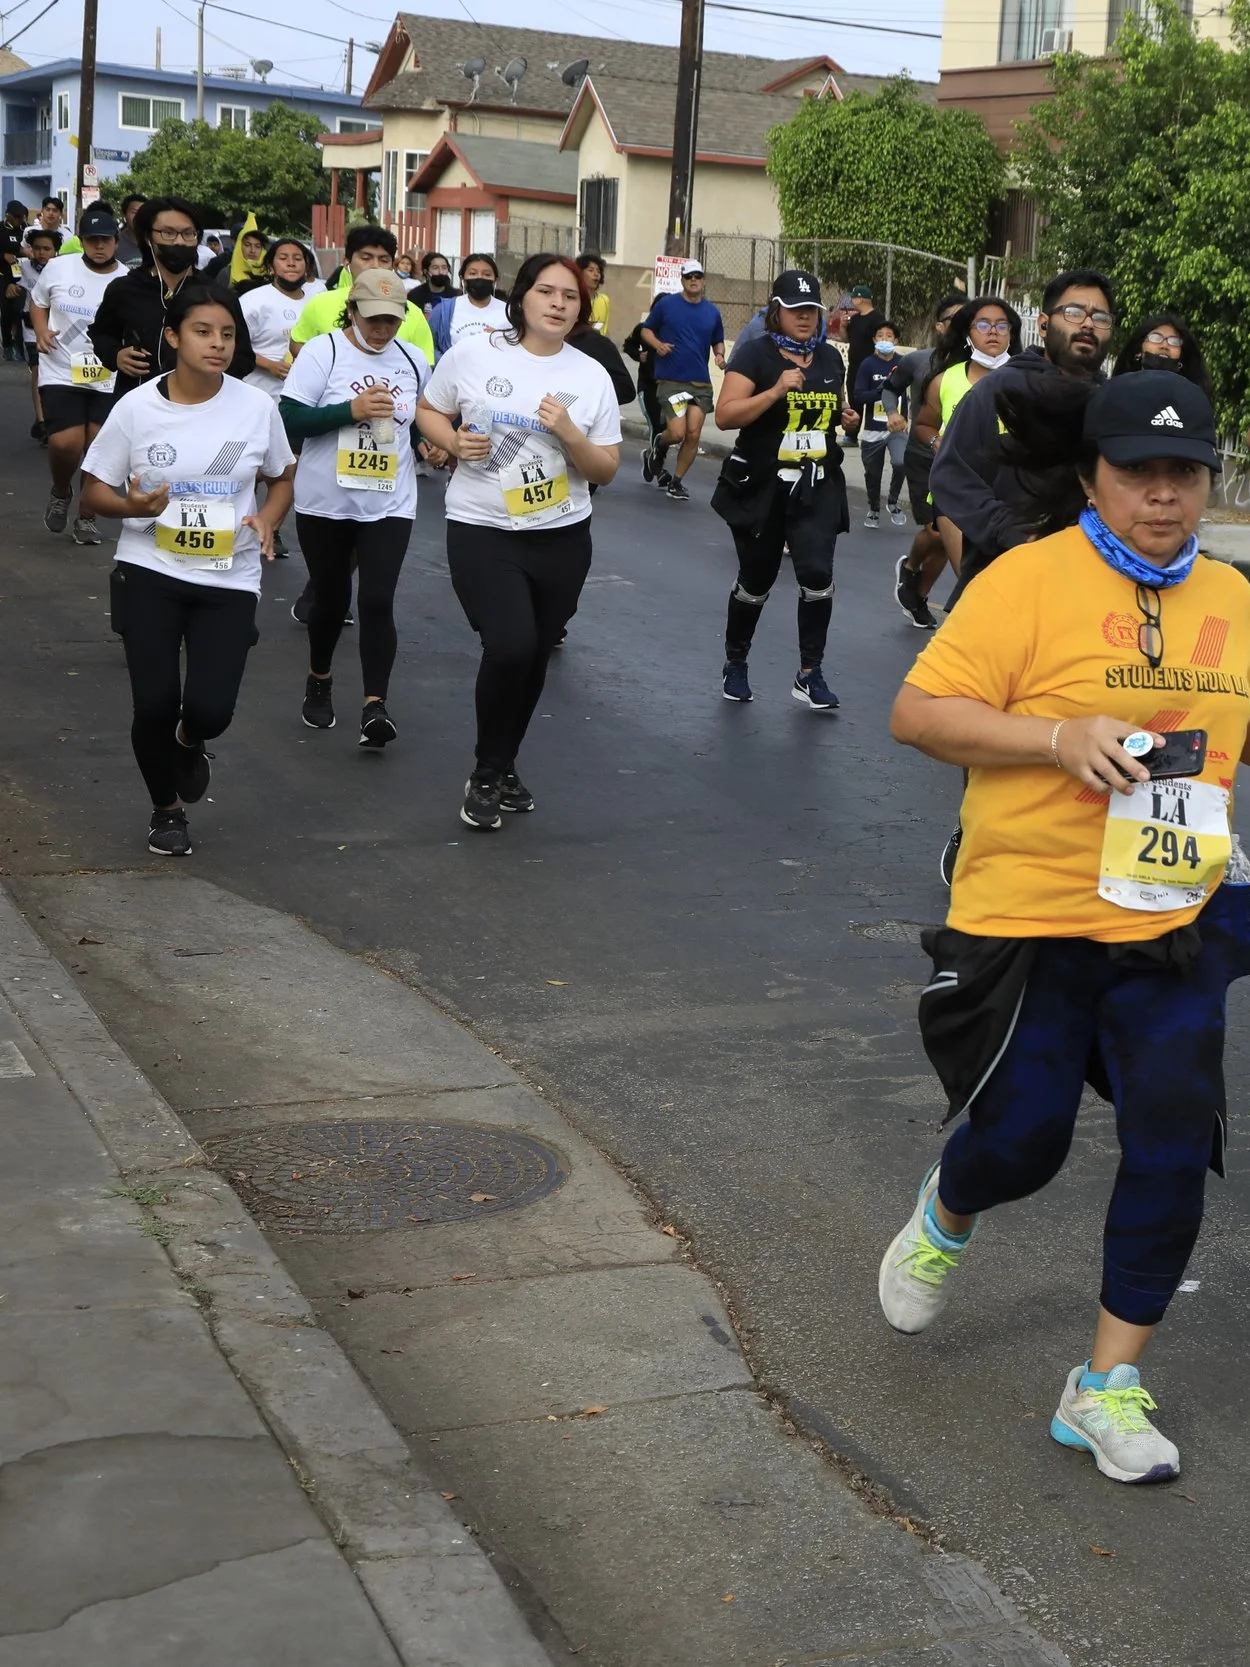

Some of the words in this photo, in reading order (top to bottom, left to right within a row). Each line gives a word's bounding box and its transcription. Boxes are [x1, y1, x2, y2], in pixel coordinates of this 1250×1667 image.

[656, 267, 669, 278] NO
[797, 277, 811, 293] LA
[82, 367, 103, 378] 687
[786, 391, 838, 402] Students
[787, 400, 838, 411] run
[492, 410, 529, 427] DENTS
[531, 418, 553, 435] RU
[1151, 418, 1183, 429] addas
[358, 437, 378, 451] LA
[796, 439, 811, 450] LA
[348, 452, 389, 471] 1245
[521, 467, 546, 484] LA
[203, 480, 228, 495] RUN
[523, 480, 553, 505] 457
[180, 511, 207, 527] LA
[174, 530, 215, 549] 456
[214, 561, 228, 569] 456
[1106, 664, 1194, 691] STUDENTS
[1196, 670, 1232, 694] RUN
[1151, 778, 1192, 791] Students
[1152, 785, 1190, 799] run
[1150, 793, 1188, 826] LA
[1137, 826, 1202, 870] 294
